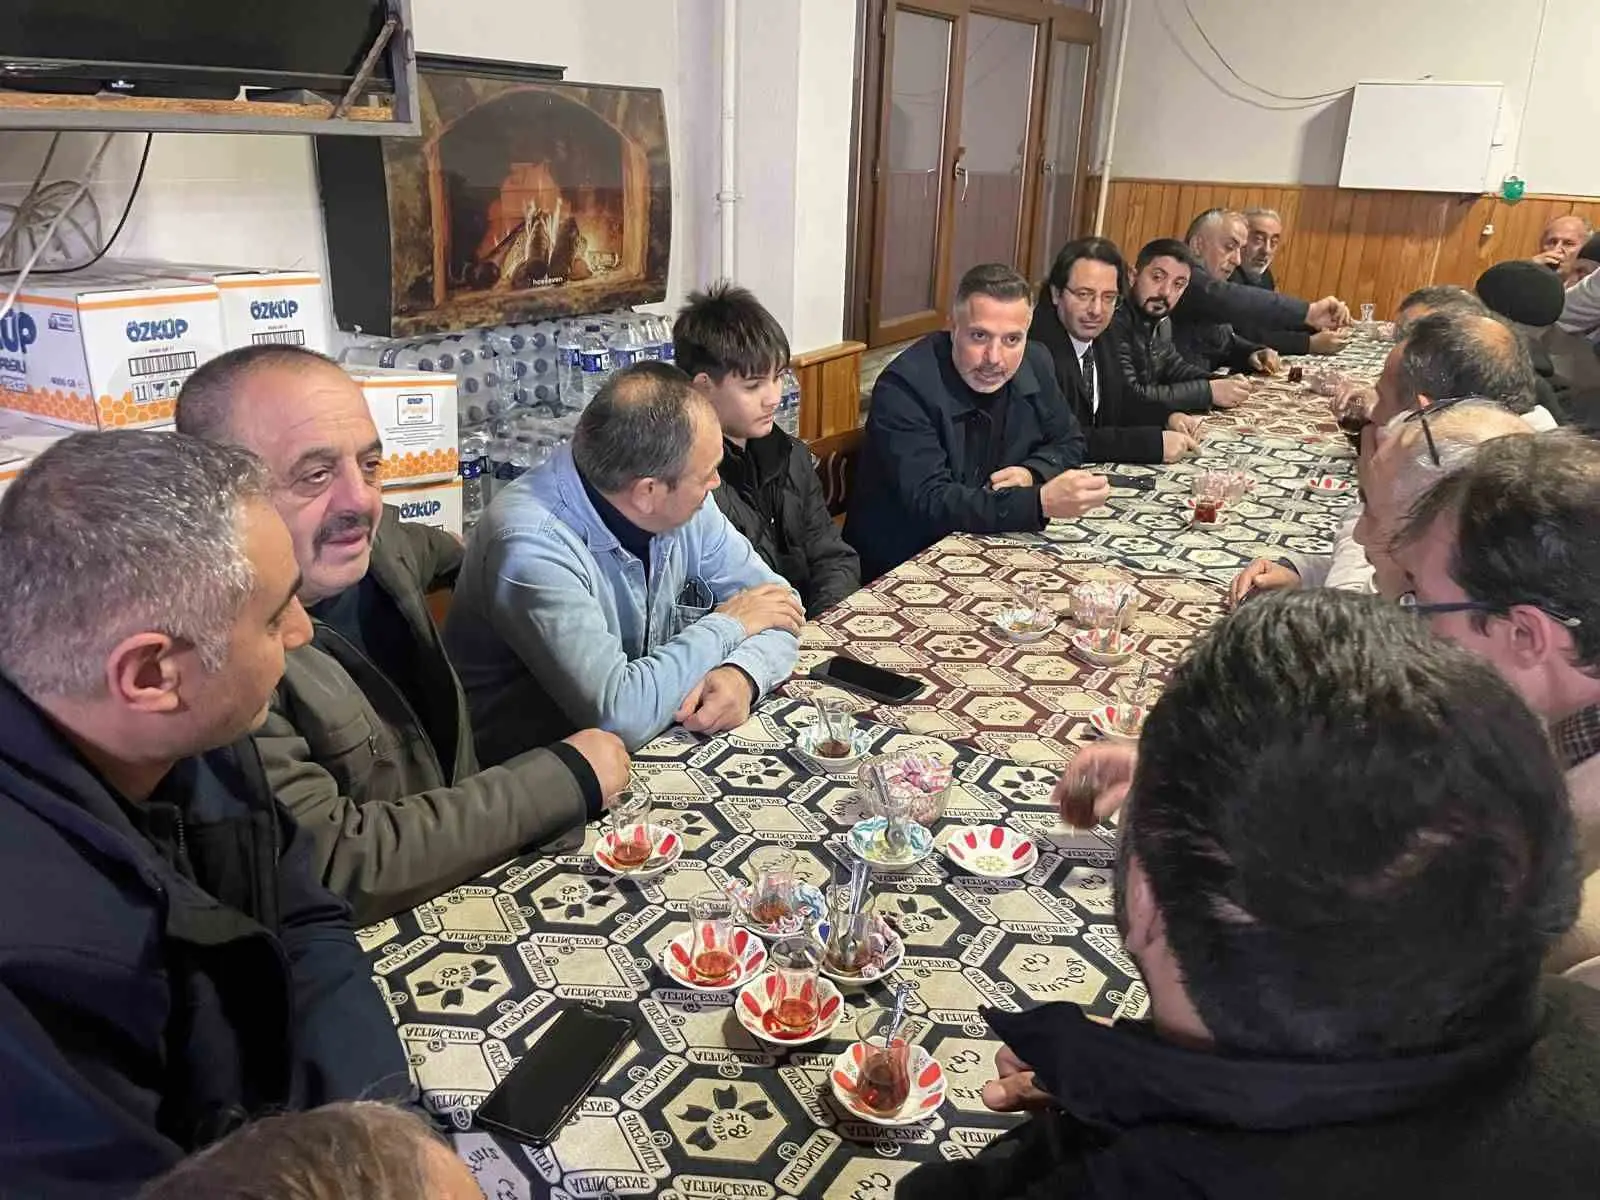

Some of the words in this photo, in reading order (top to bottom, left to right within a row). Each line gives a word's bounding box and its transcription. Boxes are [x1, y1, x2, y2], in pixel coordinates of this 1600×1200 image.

[250, 299, 298, 320] ÖZKÜP
[126, 318, 188, 342] ÖZKÜP
[400, 501, 441, 518] ÖZKÜP
